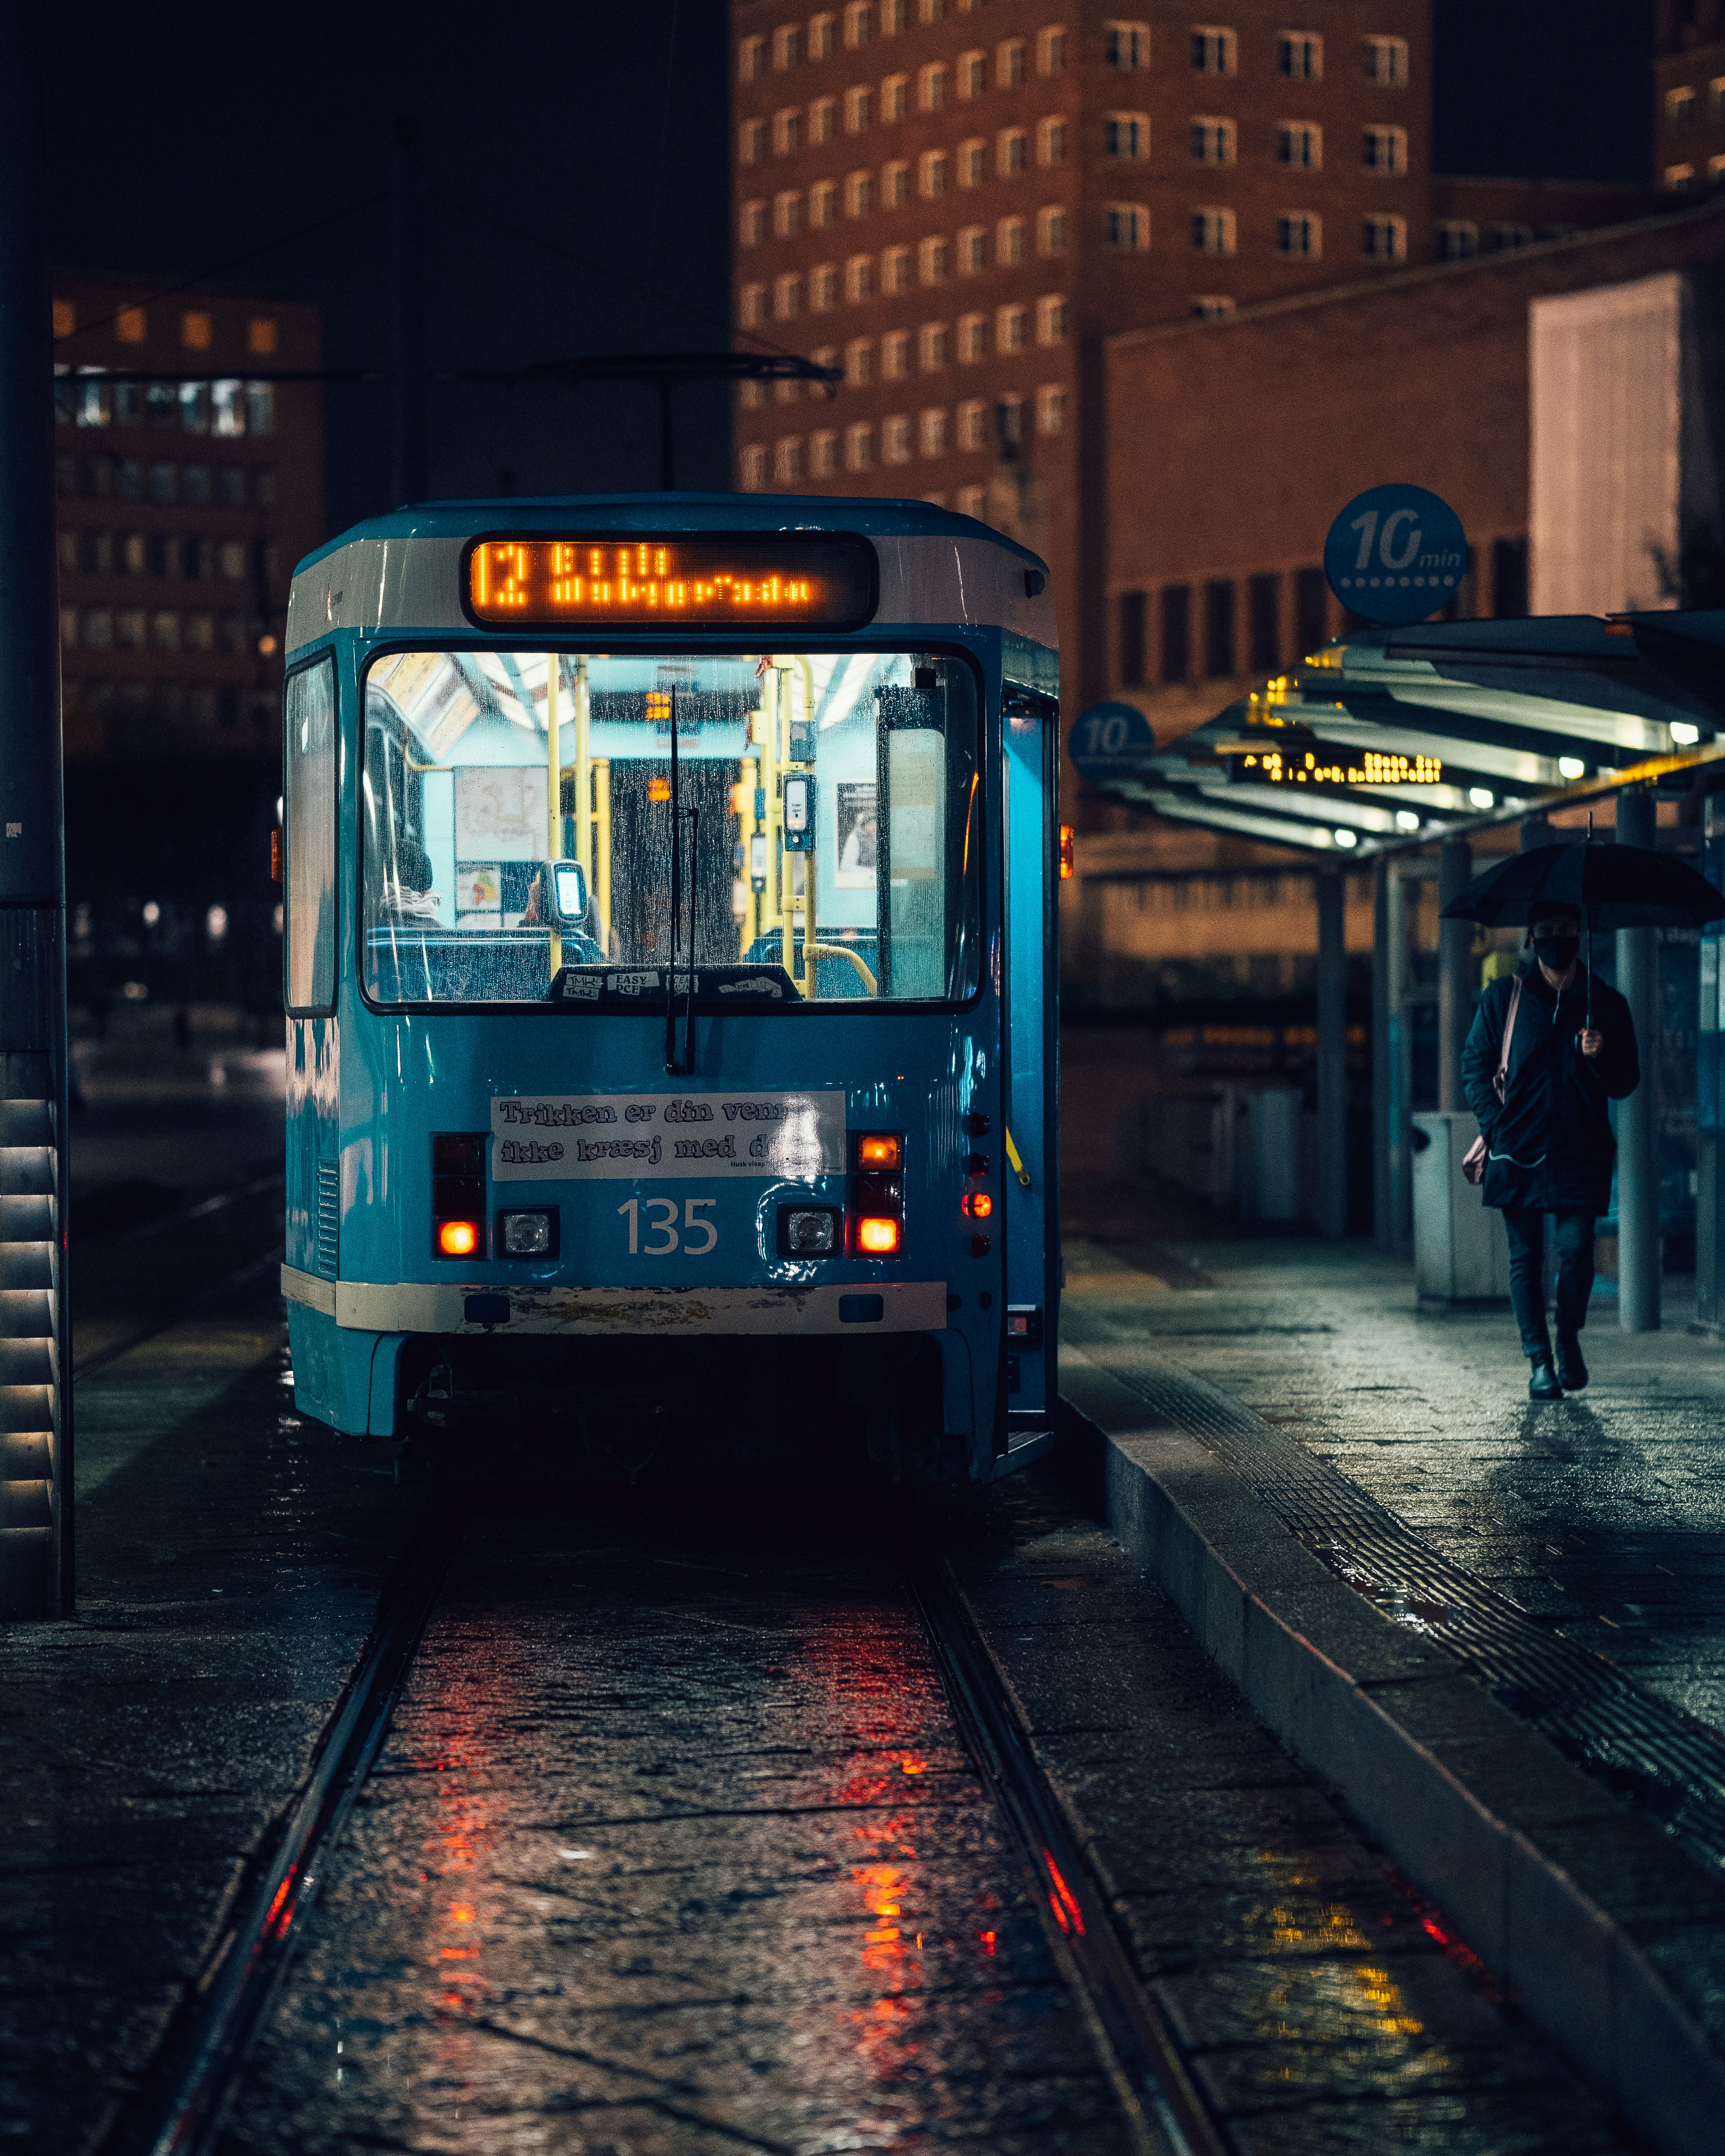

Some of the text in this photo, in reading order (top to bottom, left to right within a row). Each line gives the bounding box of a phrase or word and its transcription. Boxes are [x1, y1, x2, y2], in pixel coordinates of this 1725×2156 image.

[1350, 509, 1461, 570] 10 min
[1085, 715, 1129, 753] 10
[616, 975, 647, 985] EASY
[499, 1102, 617, 1127] Trikken
[625, 1104, 657, 1123] er
[664, 1100, 714, 1123] din
[501, 1140, 564, 1164] ikke
[577, 1135, 662, 1164] kræsj
[674, 1134, 737, 1158] med
[617, 1198, 718, 1255] 135
